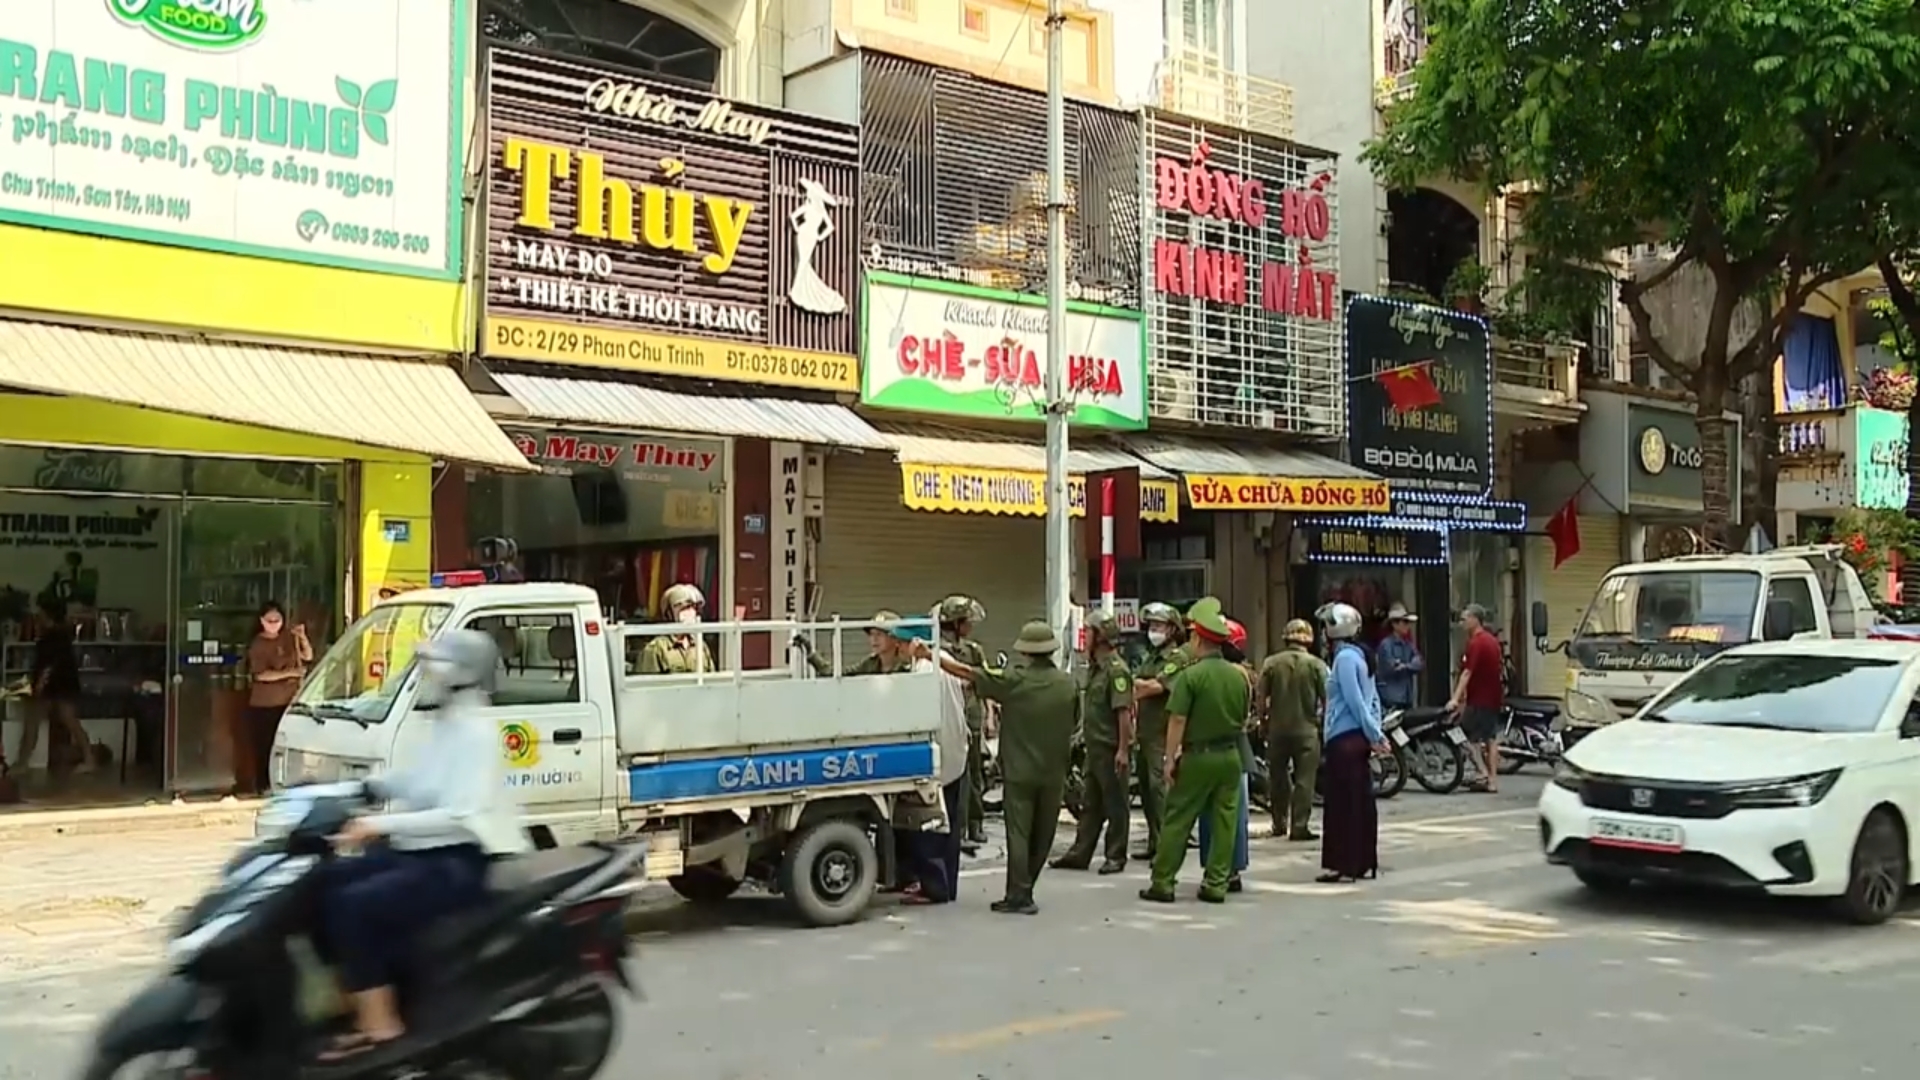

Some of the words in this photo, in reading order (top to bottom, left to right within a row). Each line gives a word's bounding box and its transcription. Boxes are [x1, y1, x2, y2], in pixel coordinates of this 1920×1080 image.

[161, 5, 227, 34] FOOD
[184, 77, 360, 160] PHÙNG
[586, 78, 678, 125] Nhà
[686, 99, 773, 146] May
[2, 171, 33, 197] Chu
[326, 170, 394, 199] ngon
[502, 136, 754, 274] Thủy
[516, 239, 575, 273] MAY
[515, 276, 585, 309] THIẾT
[589, 281, 623, 314] KẾ
[625, 291, 681, 323] THỜI
[686, 302, 762, 332] TRANG
[537, 329, 578, 353] 2/29
[583, 335, 625, 359] Phan
[628, 340, 663, 364] Chu
[666, 343, 705, 369] Trinh
[791, 354, 817, 378] 062
[821, 358, 849, 382] 072
[543, 435, 623, 467] May
[1436, 451, 1478, 474] MÙA
[783, 457, 798, 516] MAY
[952, 473, 984, 503] NEM
[1190, 476, 1234, 504] SỬA
[1238, 480, 1295, 505] CHỮA
[1301, 479, 1357, 506] ĐỒNG
[1361, 481, 1386, 507] HỒ
[784, 528, 798, 621] THIẾ
[718, 757, 805, 789] CẢNH
[822, 751, 879, 780] SÁT
